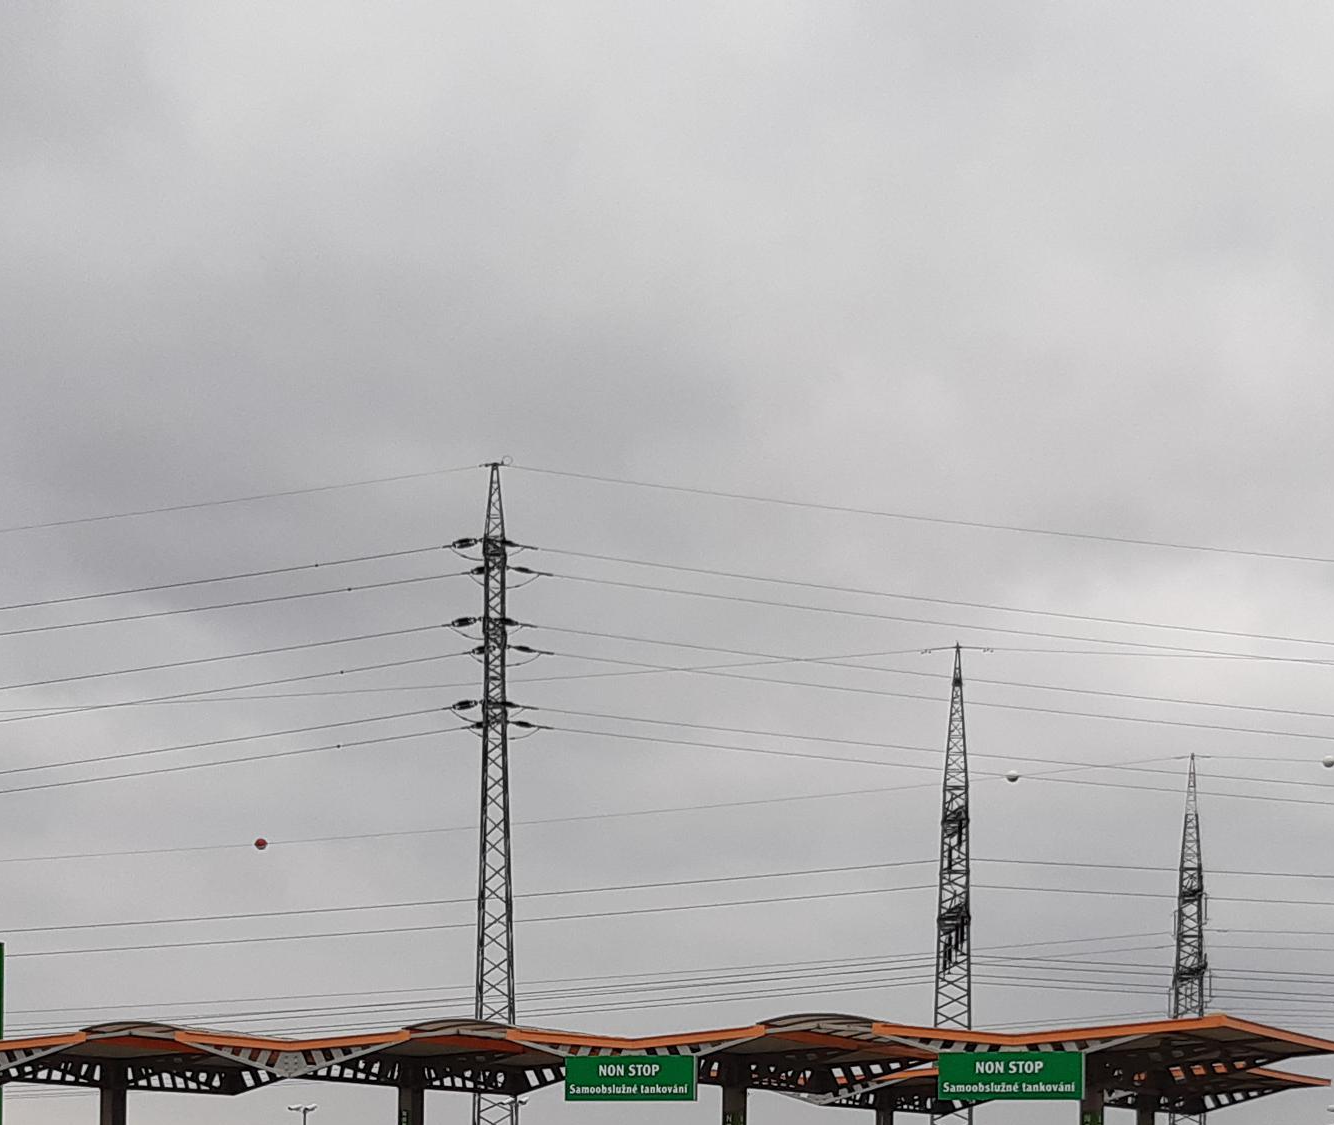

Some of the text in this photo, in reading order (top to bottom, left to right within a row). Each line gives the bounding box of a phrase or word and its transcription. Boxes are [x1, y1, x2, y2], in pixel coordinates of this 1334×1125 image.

[598, 1064, 660, 1077] NON STOP
[974, 1061, 1044, 1074] NON STOP
[569, 1083, 688, 1095] Samoobslužné tankování
[942, 1081, 1076, 1093] Samoobslužné tankování
